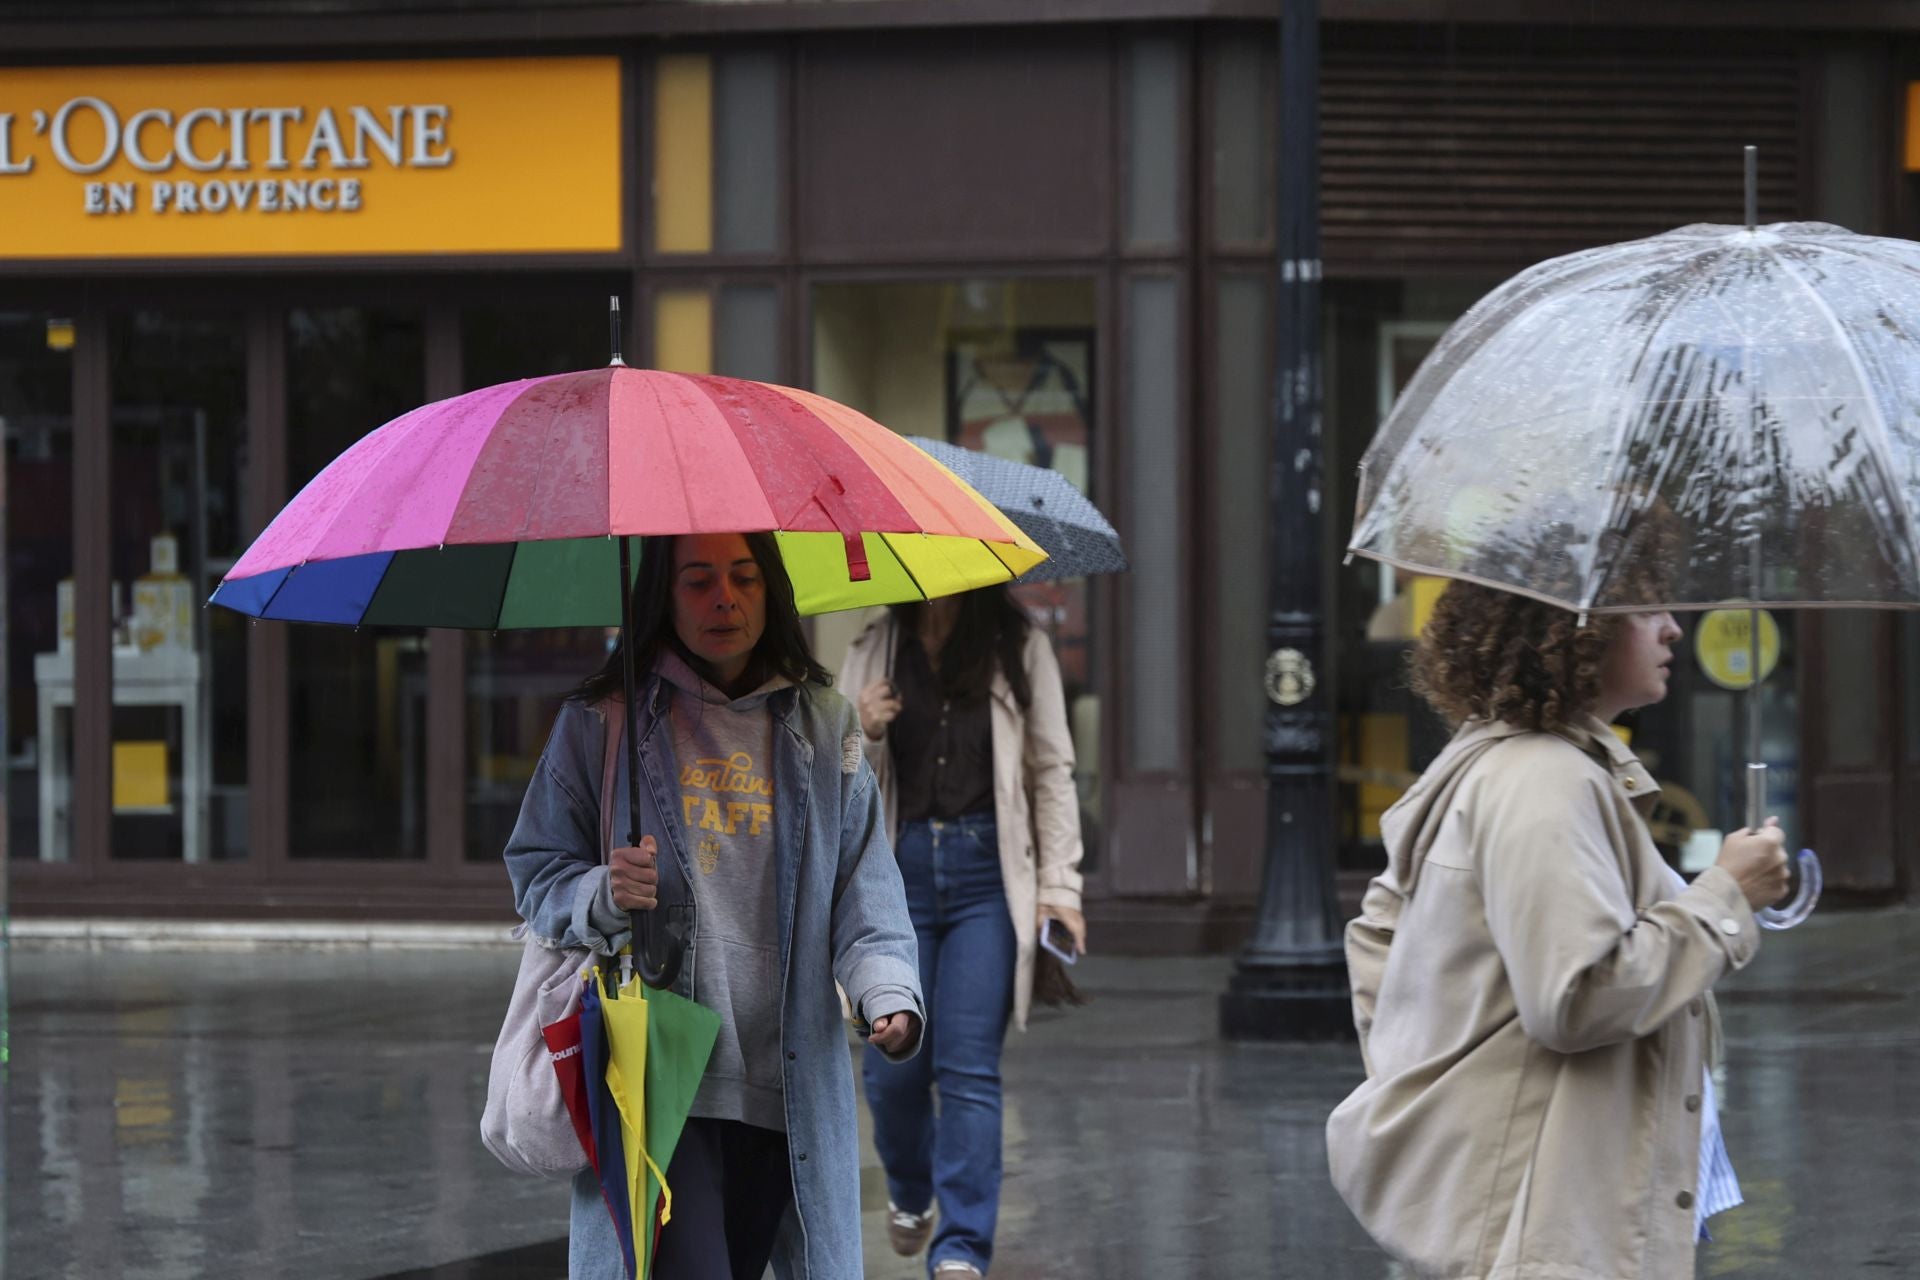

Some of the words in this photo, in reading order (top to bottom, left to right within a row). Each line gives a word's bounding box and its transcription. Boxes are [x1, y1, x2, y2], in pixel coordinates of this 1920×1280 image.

[0, 96, 454, 174] L'OCCITANE
[84, 181, 135, 214] EN
[152, 177, 362, 213] PROVENCE
